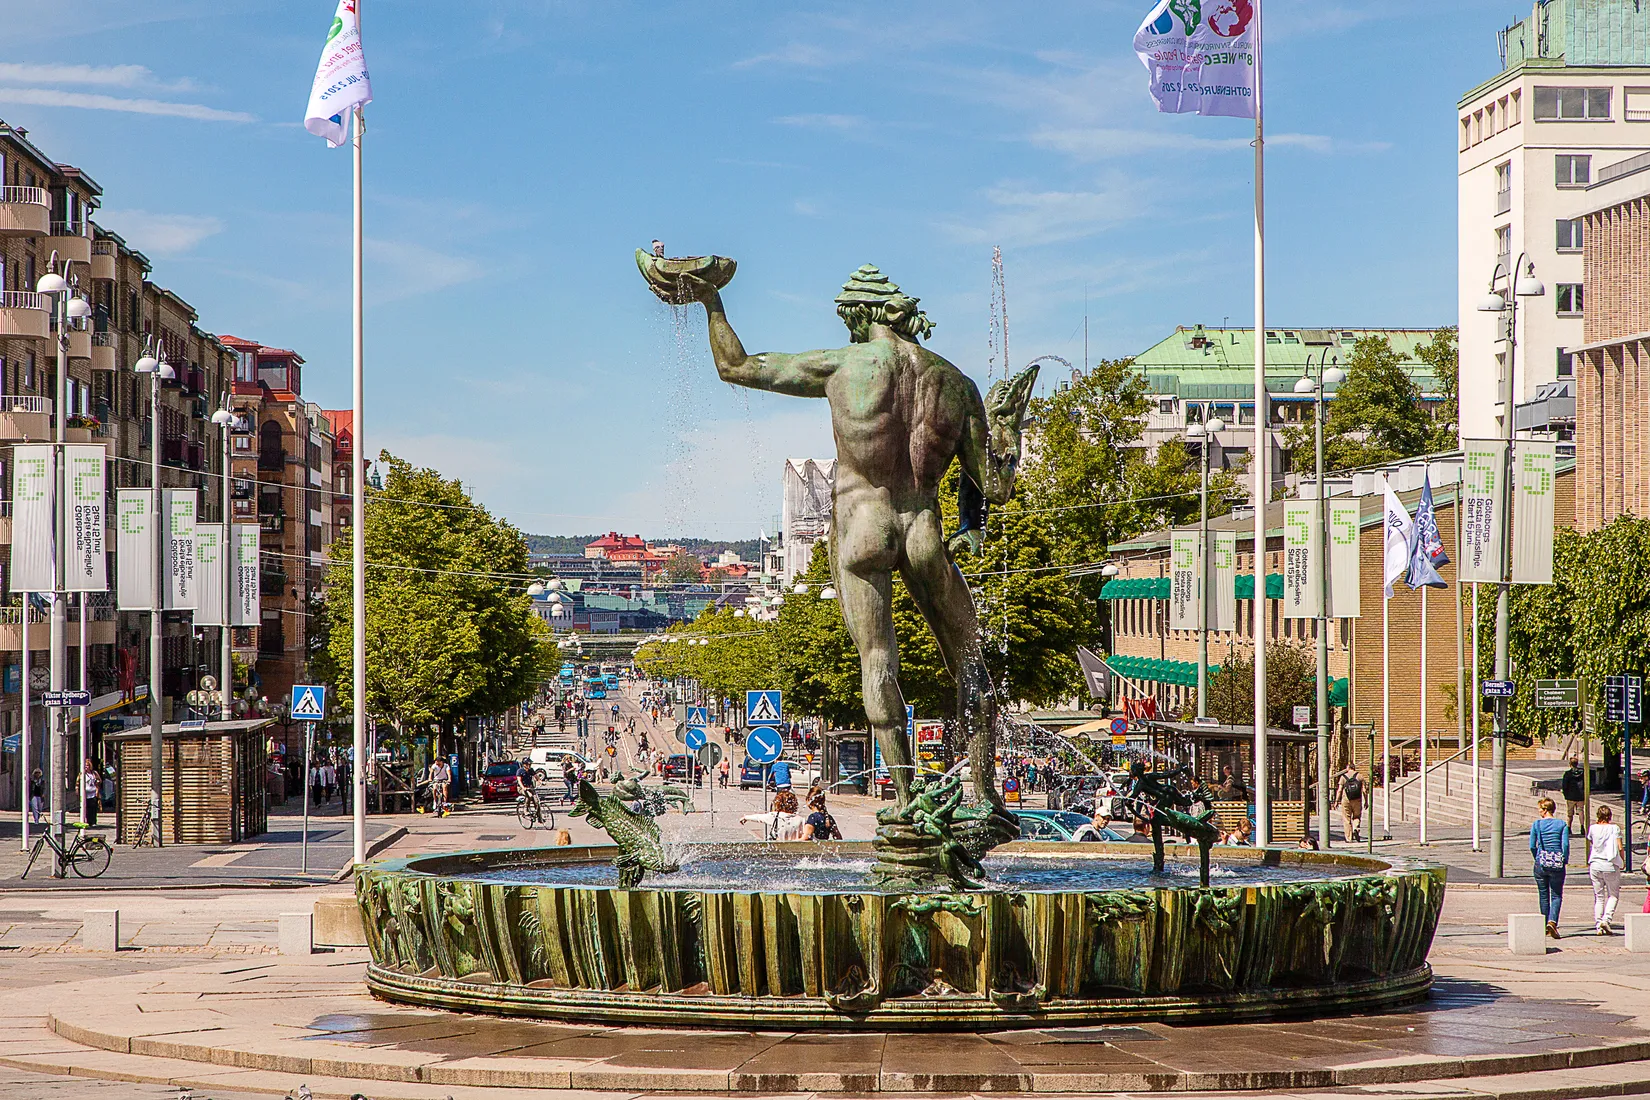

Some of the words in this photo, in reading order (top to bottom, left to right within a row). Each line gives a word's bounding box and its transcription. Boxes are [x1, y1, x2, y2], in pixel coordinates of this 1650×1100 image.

[1476, 498, 1484, 522] första
[1483, 499, 1493, 543] Göteborgs
[1467, 520, 1474, 529] 15
[1474, 524, 1483, 568] elbusslinje.
[1288, 566, 1294, 574] 15
